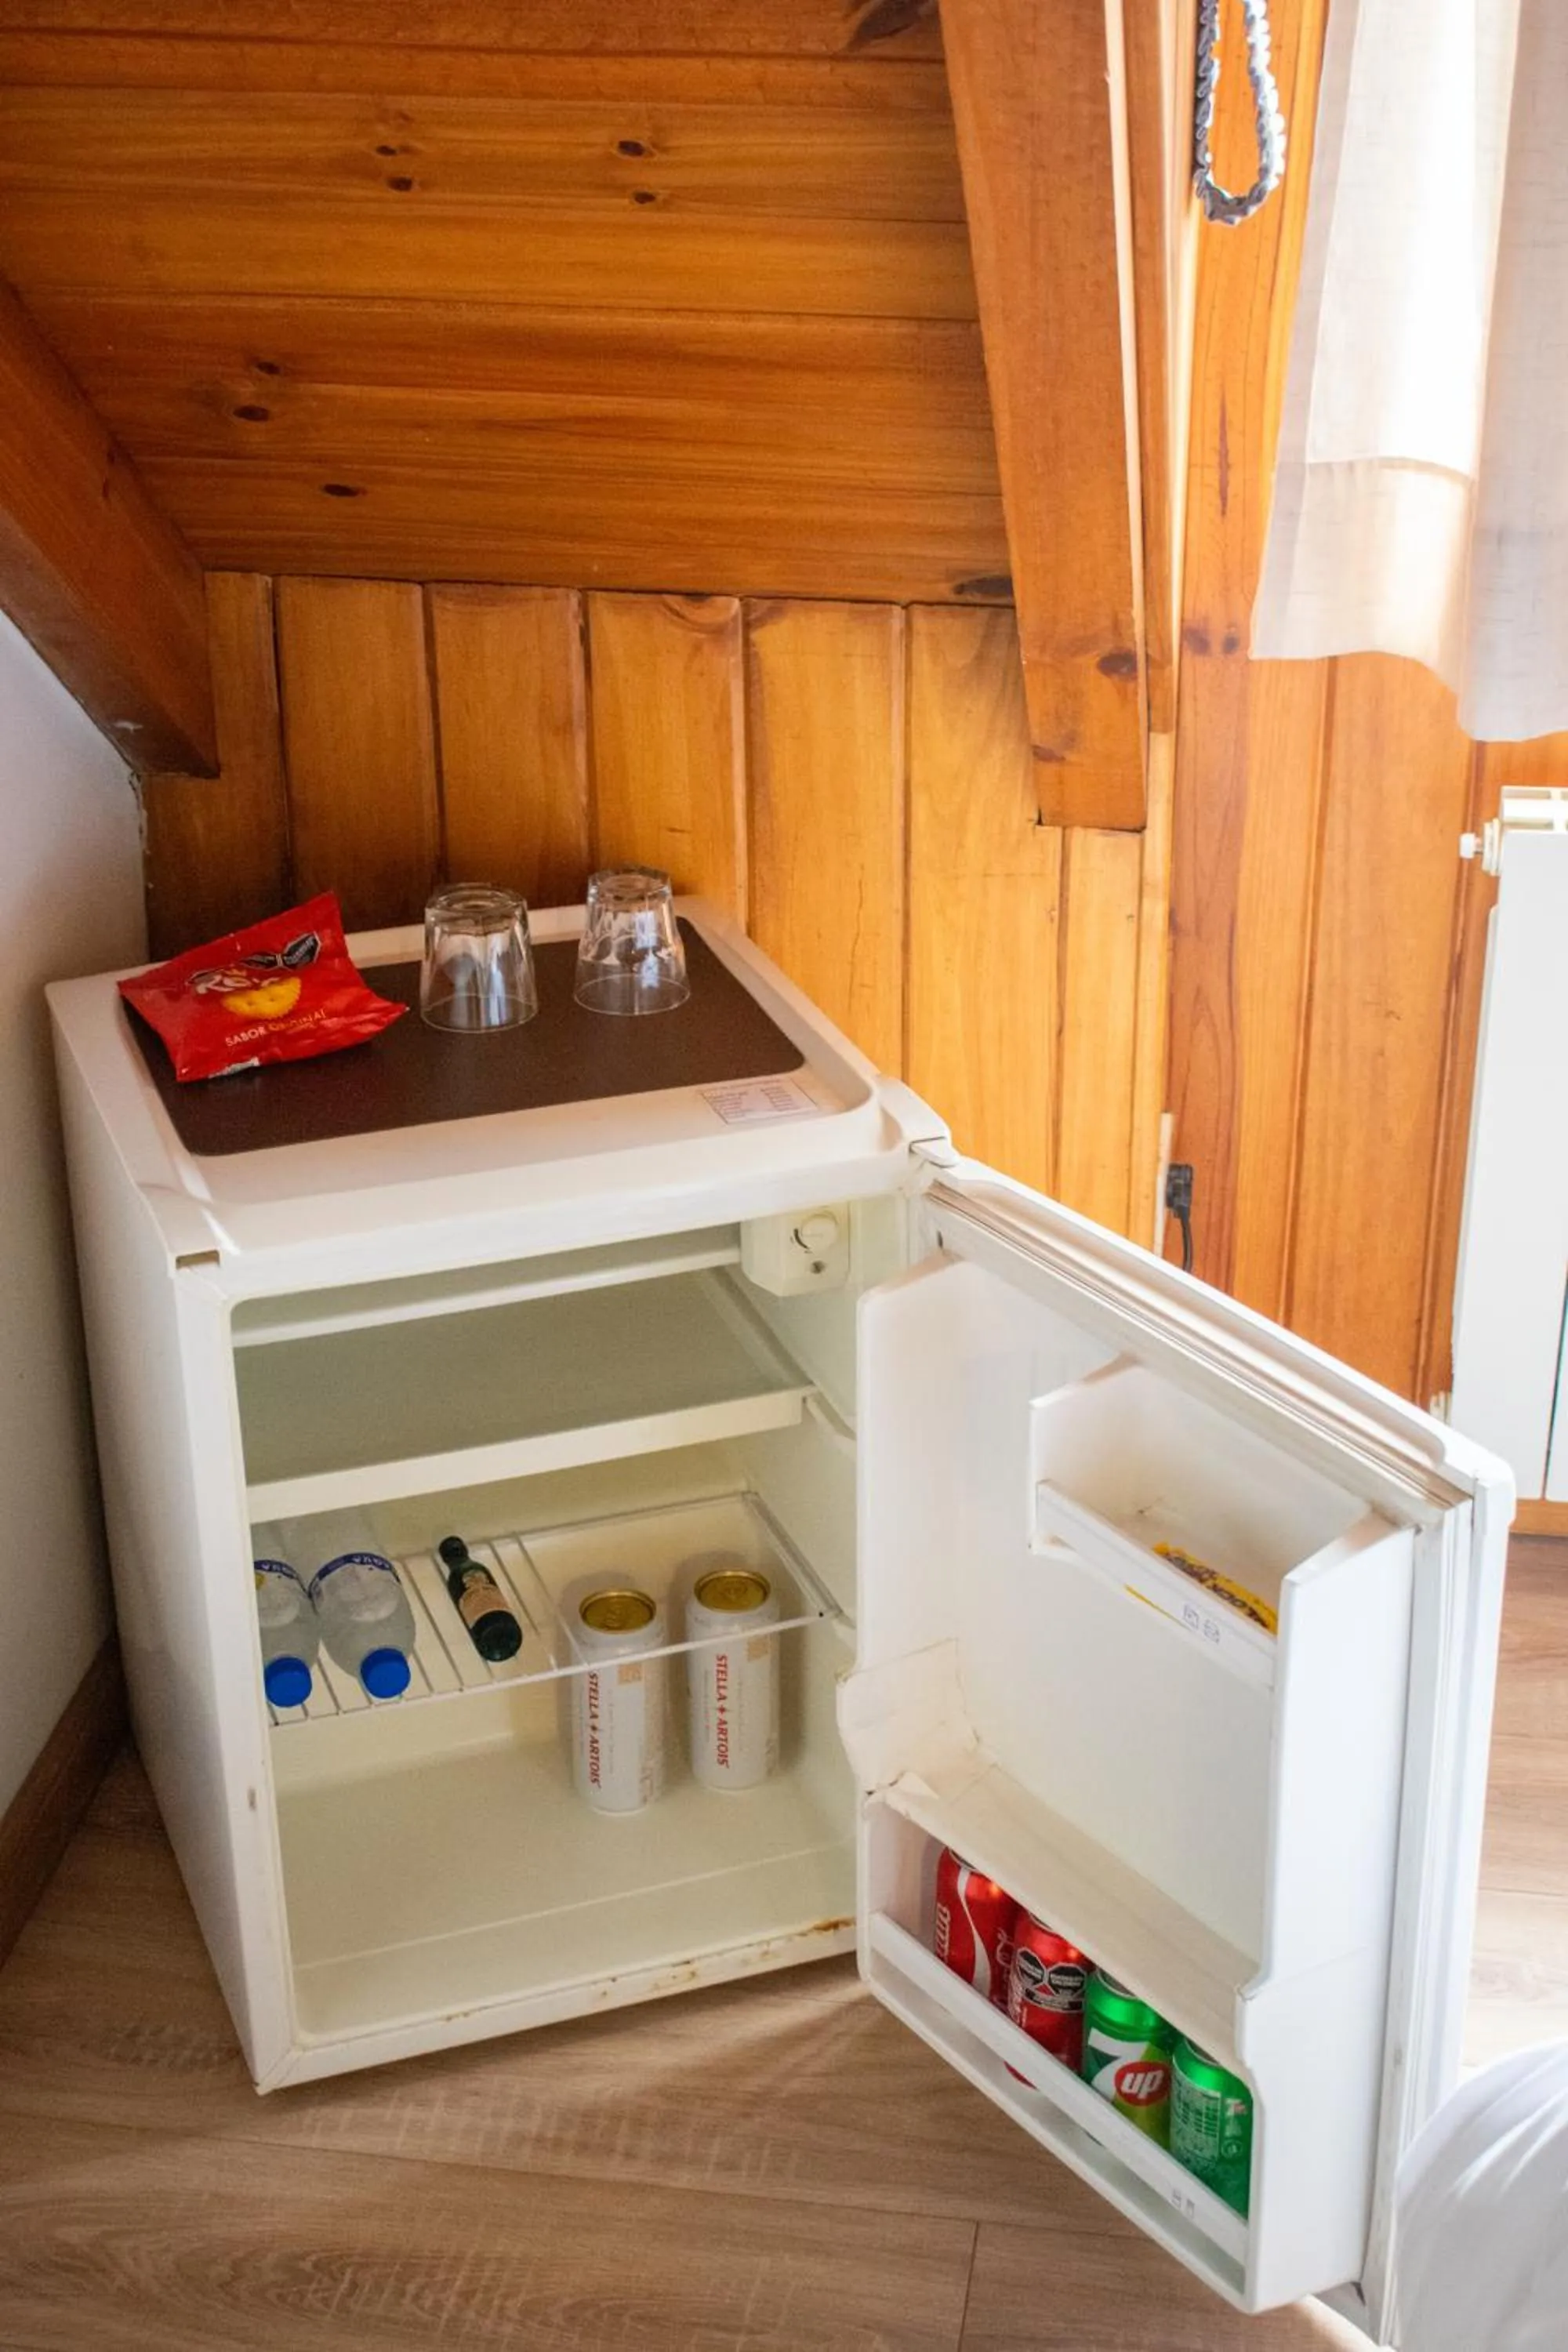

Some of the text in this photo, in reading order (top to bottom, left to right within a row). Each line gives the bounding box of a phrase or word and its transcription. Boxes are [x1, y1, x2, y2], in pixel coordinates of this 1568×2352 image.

[225, 1026, 267, 1047] SABOR
[588, 1672, 601, 1789] STELLA ARTOIS
[716, 1654, 730, 1769] STELLA ARTOIS
